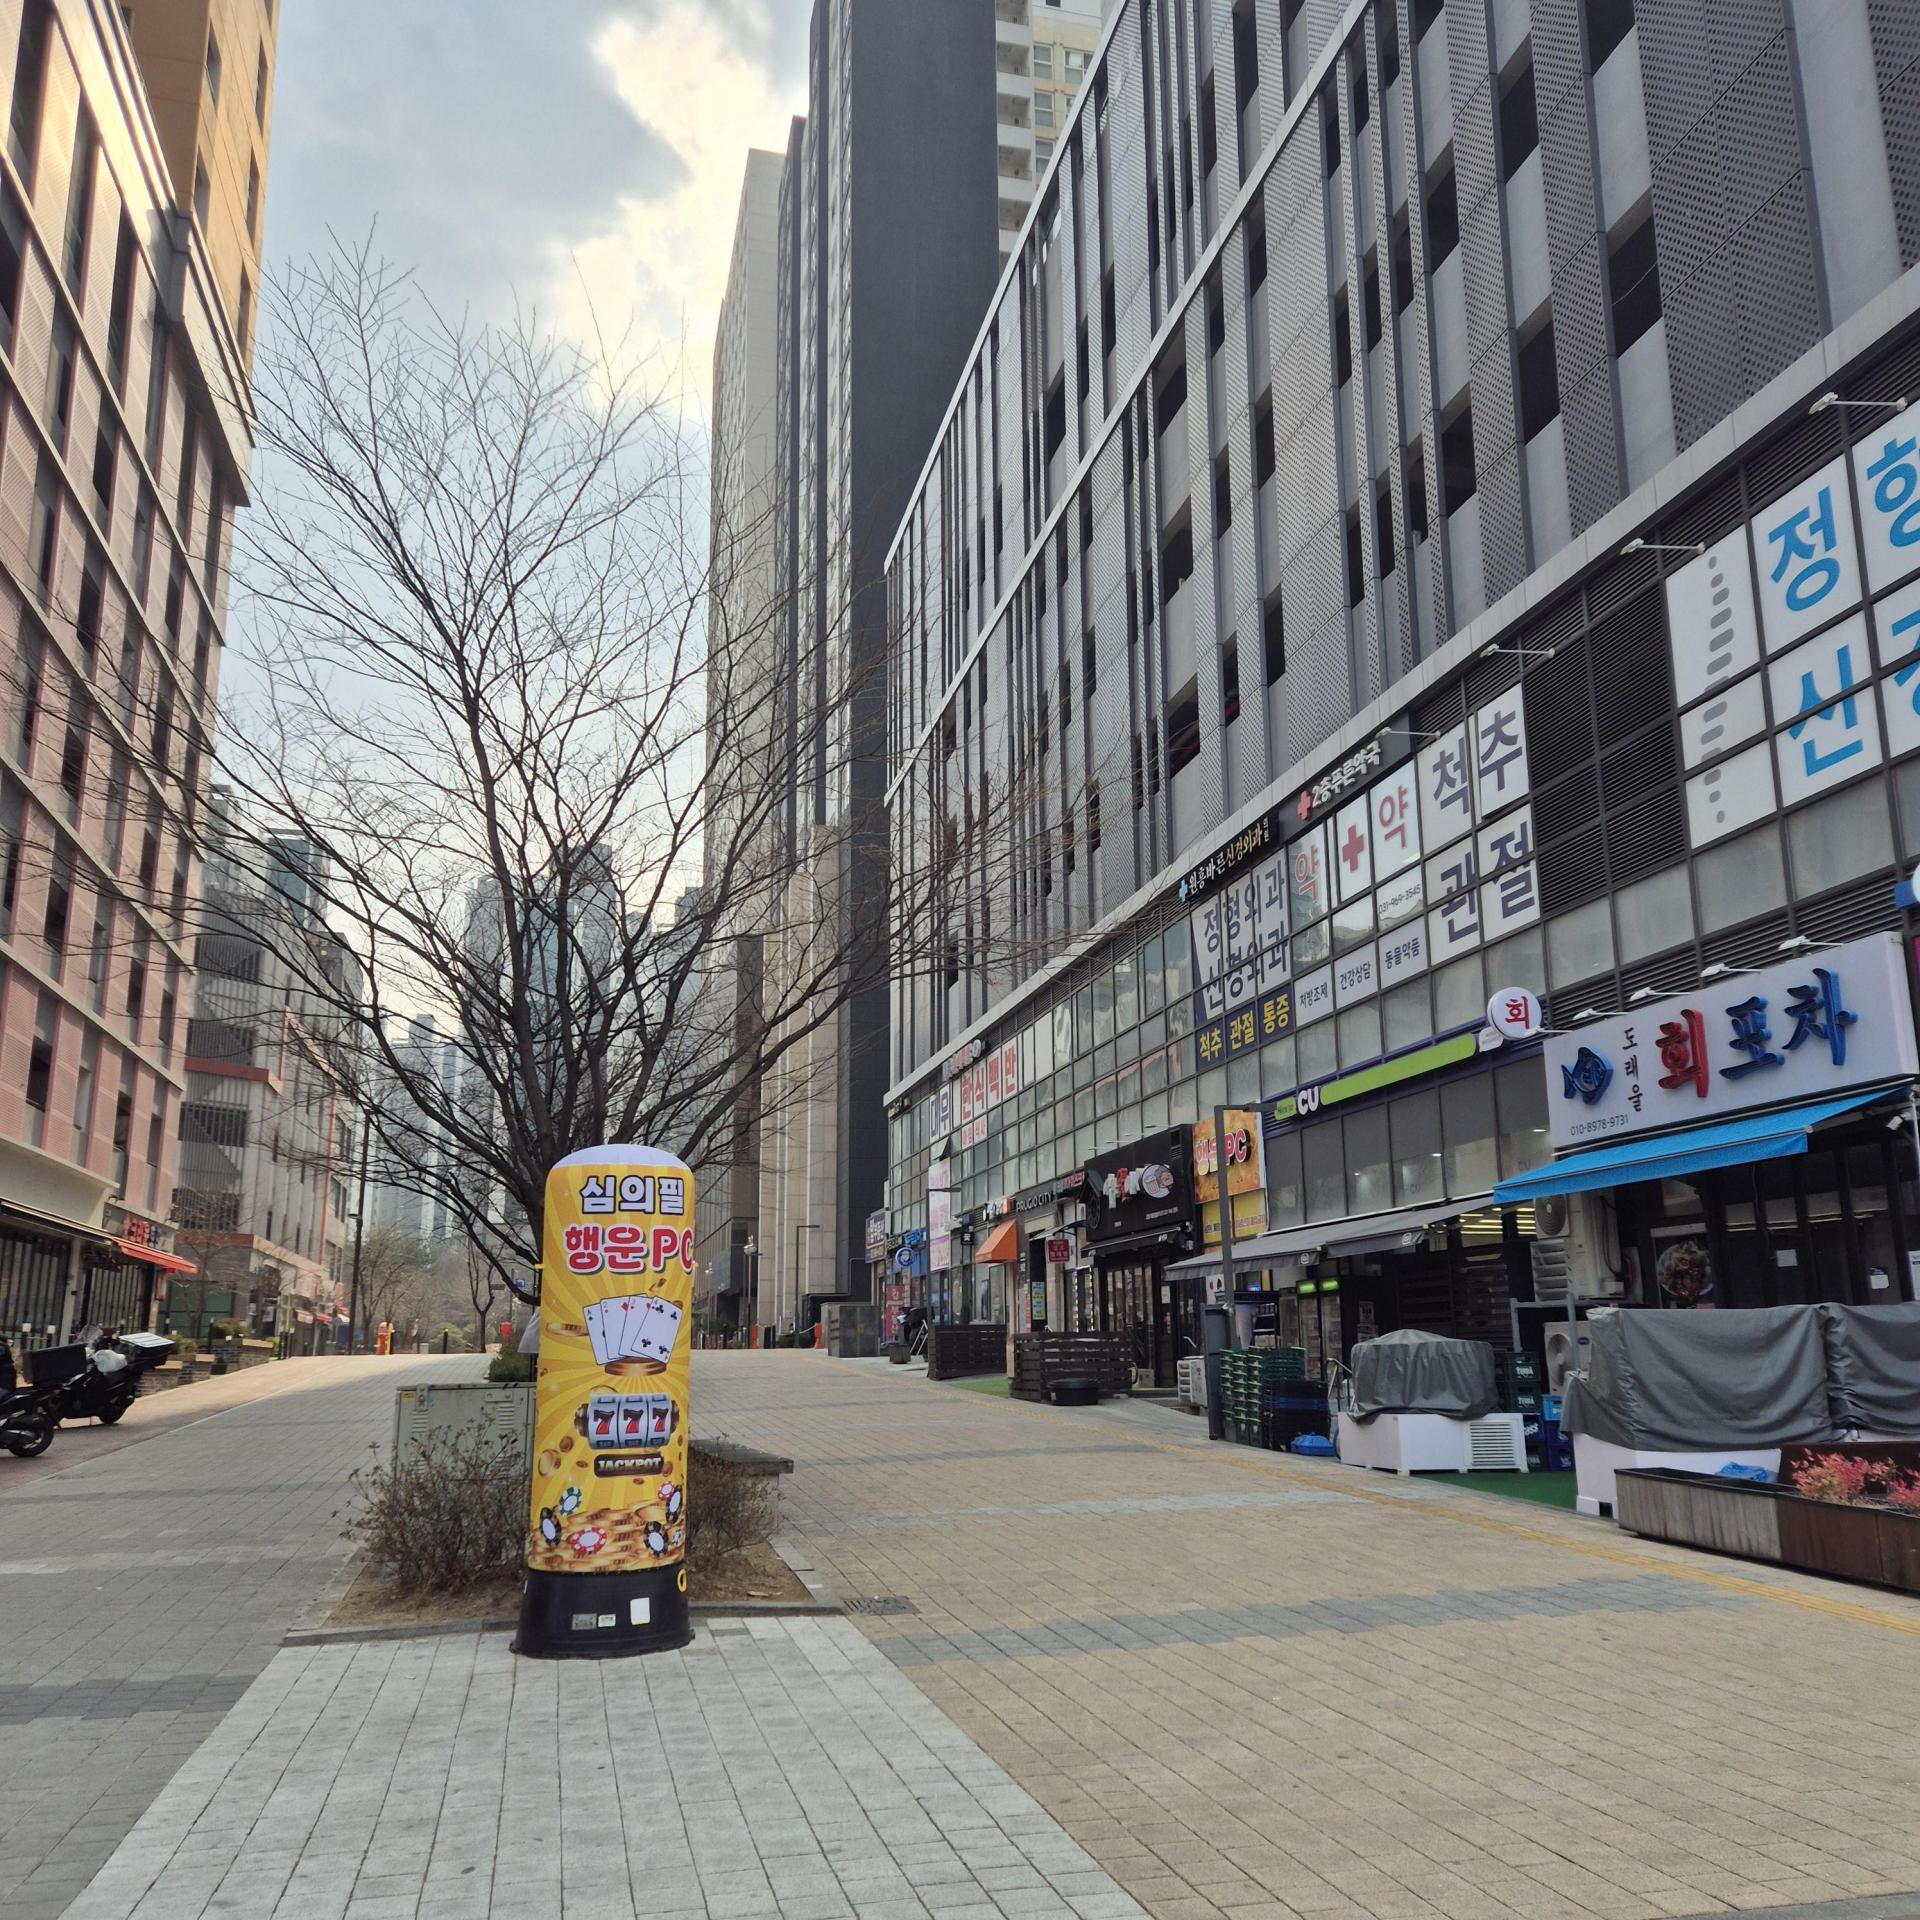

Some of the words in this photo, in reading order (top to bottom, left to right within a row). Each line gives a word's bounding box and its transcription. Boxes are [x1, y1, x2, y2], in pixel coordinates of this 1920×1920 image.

[1788, 606, 1920, 777] 신
[1311, 740, 1381, 809] 2층푸른약국
[1433, 710, 1523, 815] 척추
[1379, 784, 1409, 849] 약
[1294, 844, 1319, 903] 약
[1441, 821, 1535, 943] 관절
[1203, 859, 1285, 953] 정형외과
[1205, 920, 1288, 1010] 신경외과
[1339, 960, 1372, 991] 건강상담
[1384, 937, 1421, 970] 동물약품
[1199, 1026, 1222, 1062] 척추
[1229, 1009, 1255, 1051] 관절
[1263, 992, 1290, 1035] 통증
[1505, 995, 1530, 1030] 회
[961, 1045, 1017, 1121] 한식백반
[1297, 1085, 1319, 1116] CU
[1570, 1114, 1629, 1137] 010-8978-9731
[580, 1175, 685, 1215] 심의필
[1016, 1196, 1038, 1213] PRUGIO
[1038, 1191, 1053, 1206] CITY
[564, 1224, 693, 1275] 행운PC
[598, 1457, 662, 1474] JACKPOT
